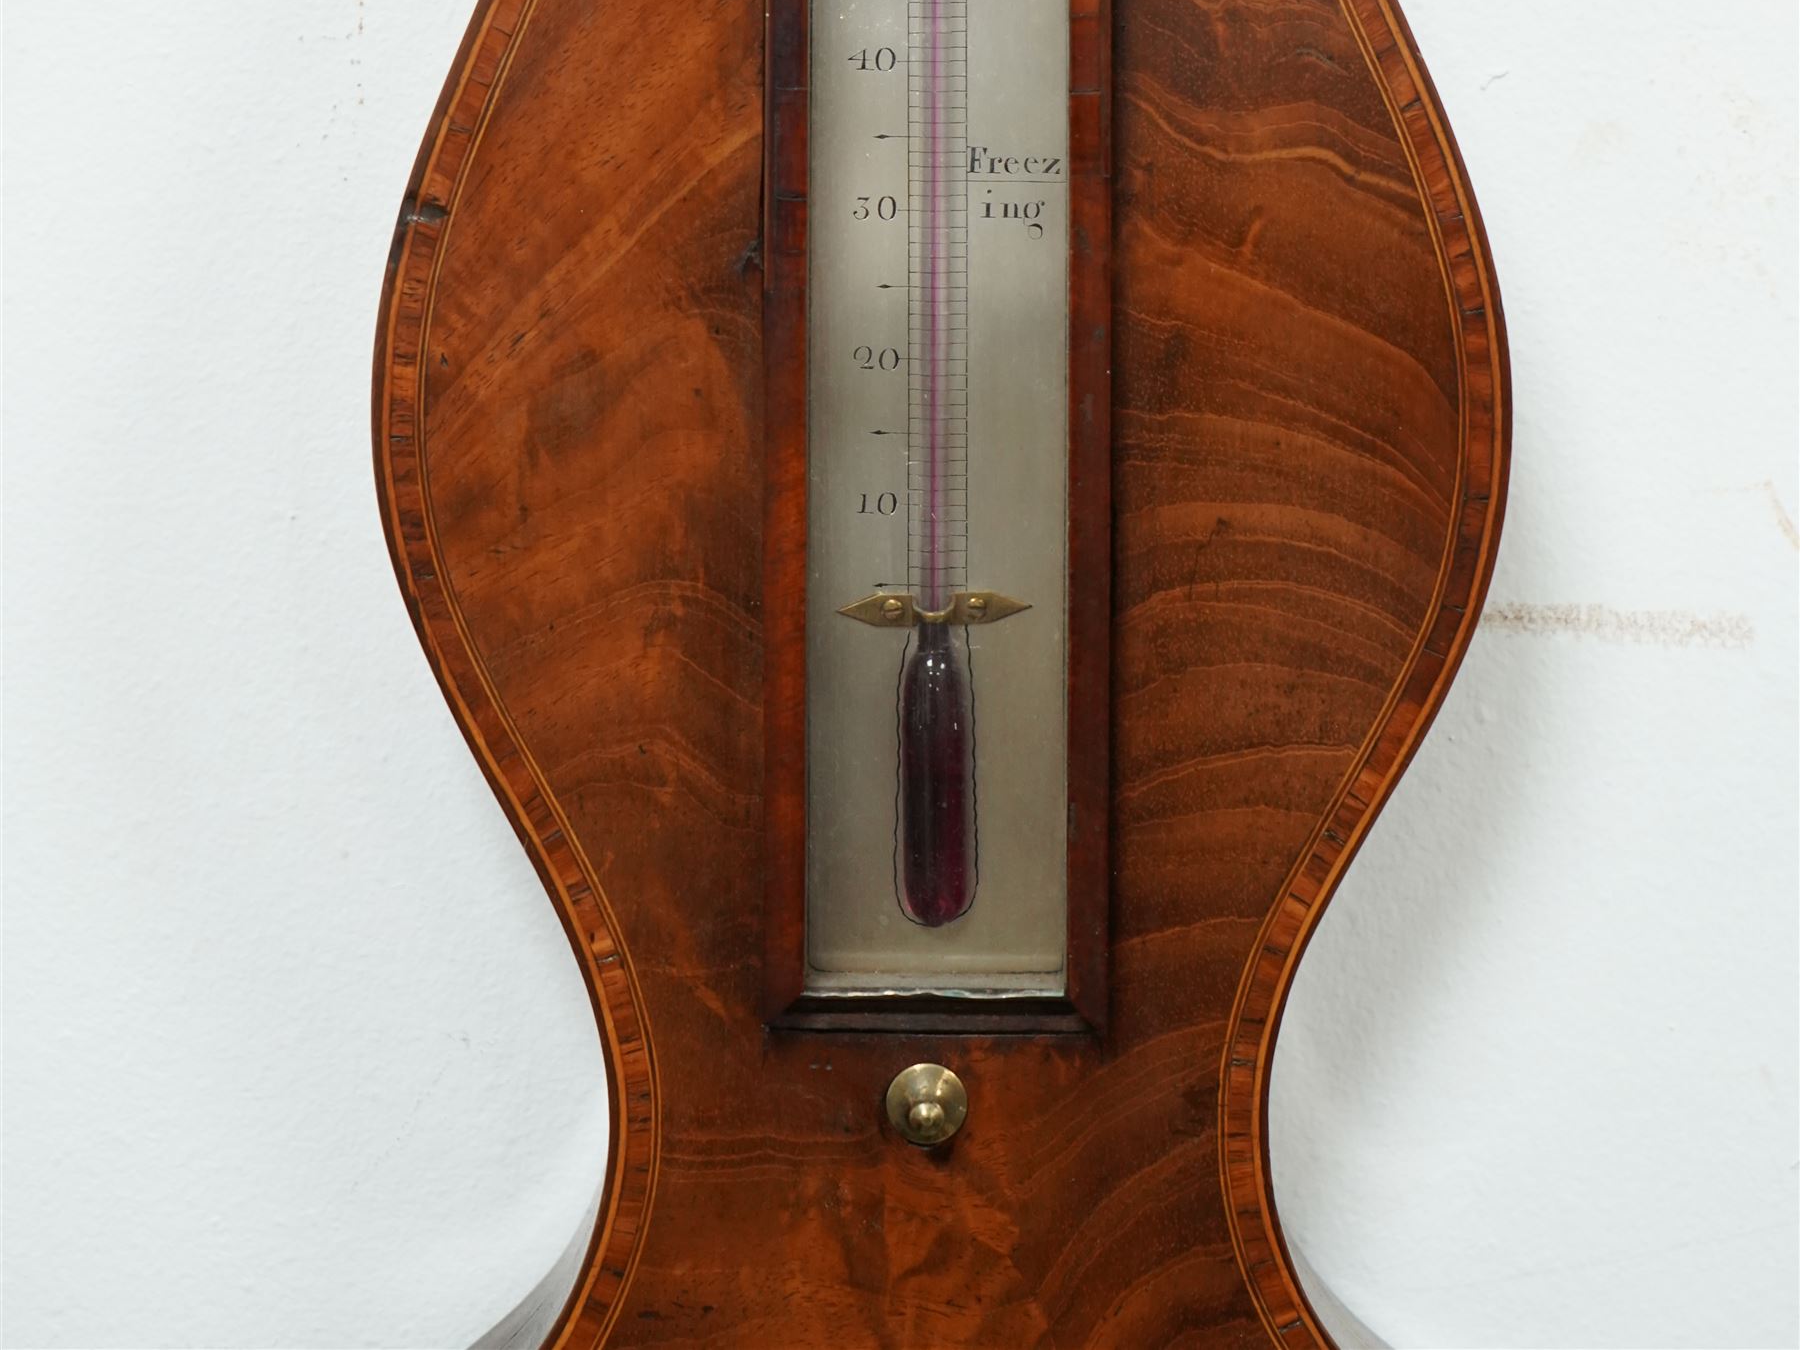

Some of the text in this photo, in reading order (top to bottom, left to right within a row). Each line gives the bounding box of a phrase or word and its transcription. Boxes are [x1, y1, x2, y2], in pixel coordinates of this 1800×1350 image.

[847, 47, 897, 72] 40
[966, 145, 1062, 175] Freez
[852, 195, 897, 221] 30
[979, 188, 1046, 240] ing
[852, 345, 900, 371] 20
[856, 491, 898, 516] 10
